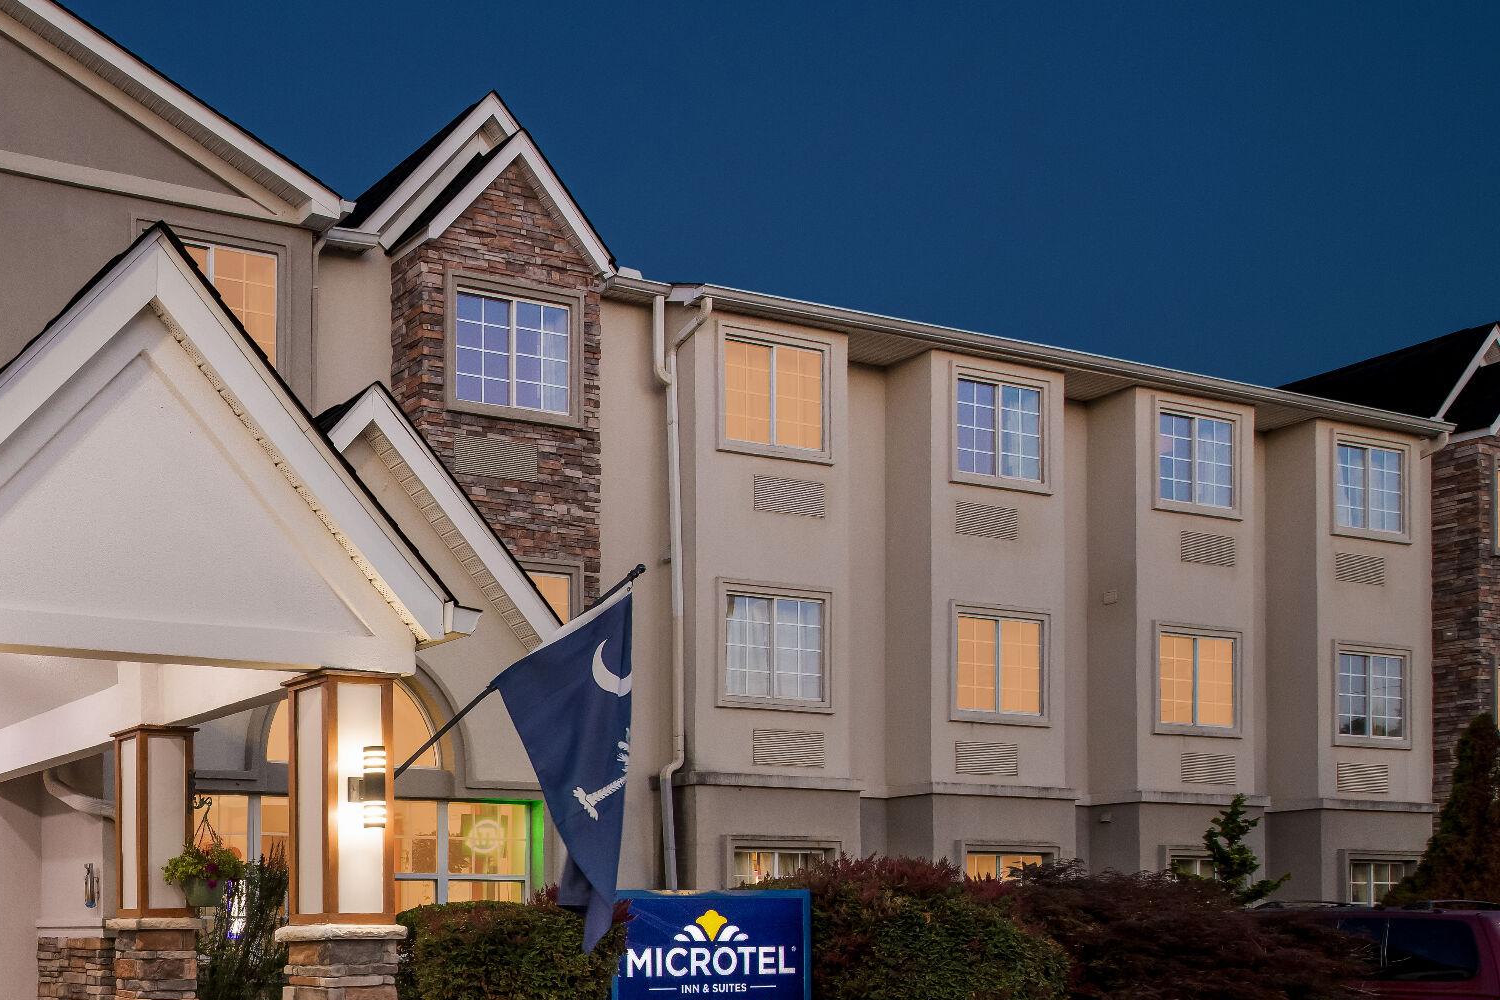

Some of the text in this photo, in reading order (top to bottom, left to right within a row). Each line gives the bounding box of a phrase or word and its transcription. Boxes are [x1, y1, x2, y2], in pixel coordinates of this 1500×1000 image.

[626, 946, 796, 978] MICROTEL
[681, 983, 747, 994] INN & SUITES
